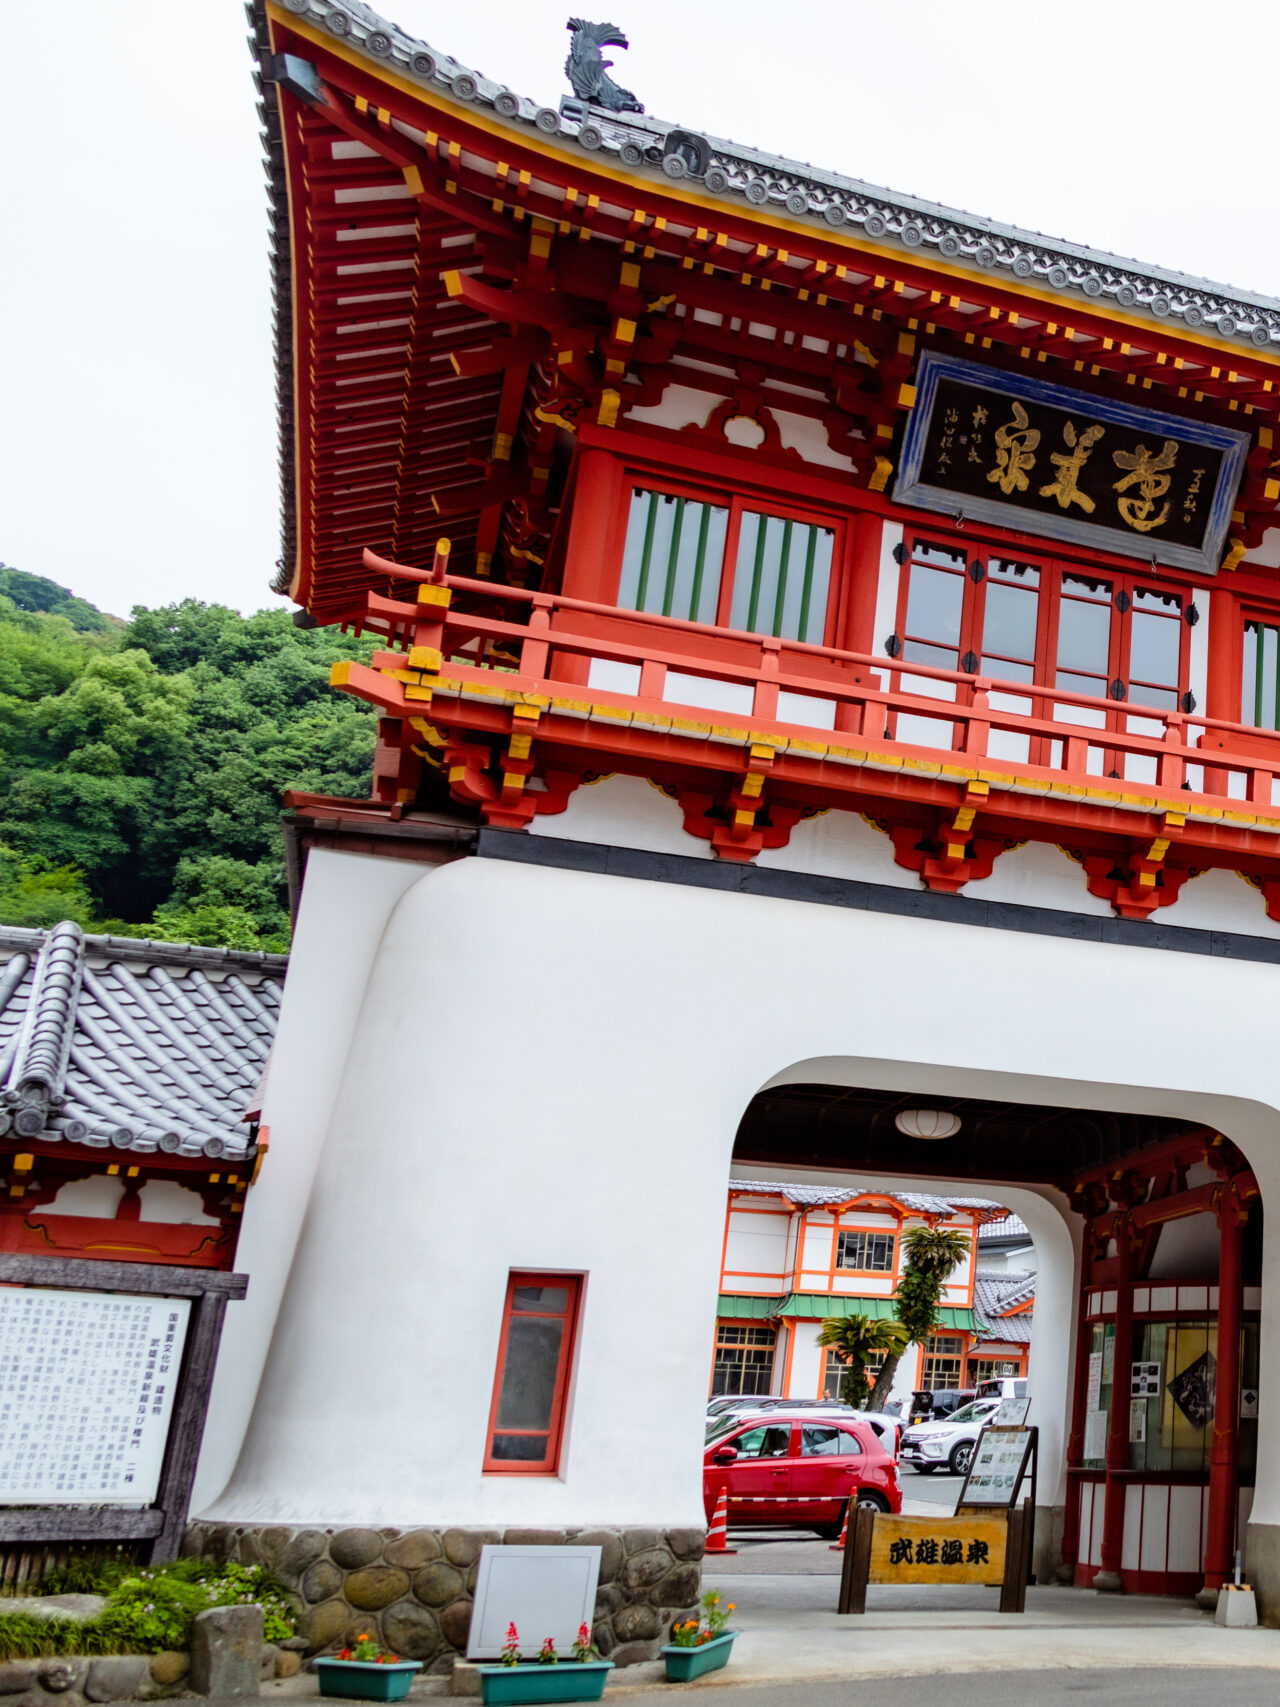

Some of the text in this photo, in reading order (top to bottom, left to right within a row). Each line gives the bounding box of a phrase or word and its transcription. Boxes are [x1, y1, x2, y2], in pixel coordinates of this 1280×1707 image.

[130, 1338, 160, 1448] 武雄温泉新館及び楼門
[150, 1312, 179, 1415] 国重要文化財 建造物
[889, 1537, 989, 1565] 武雄温泉
